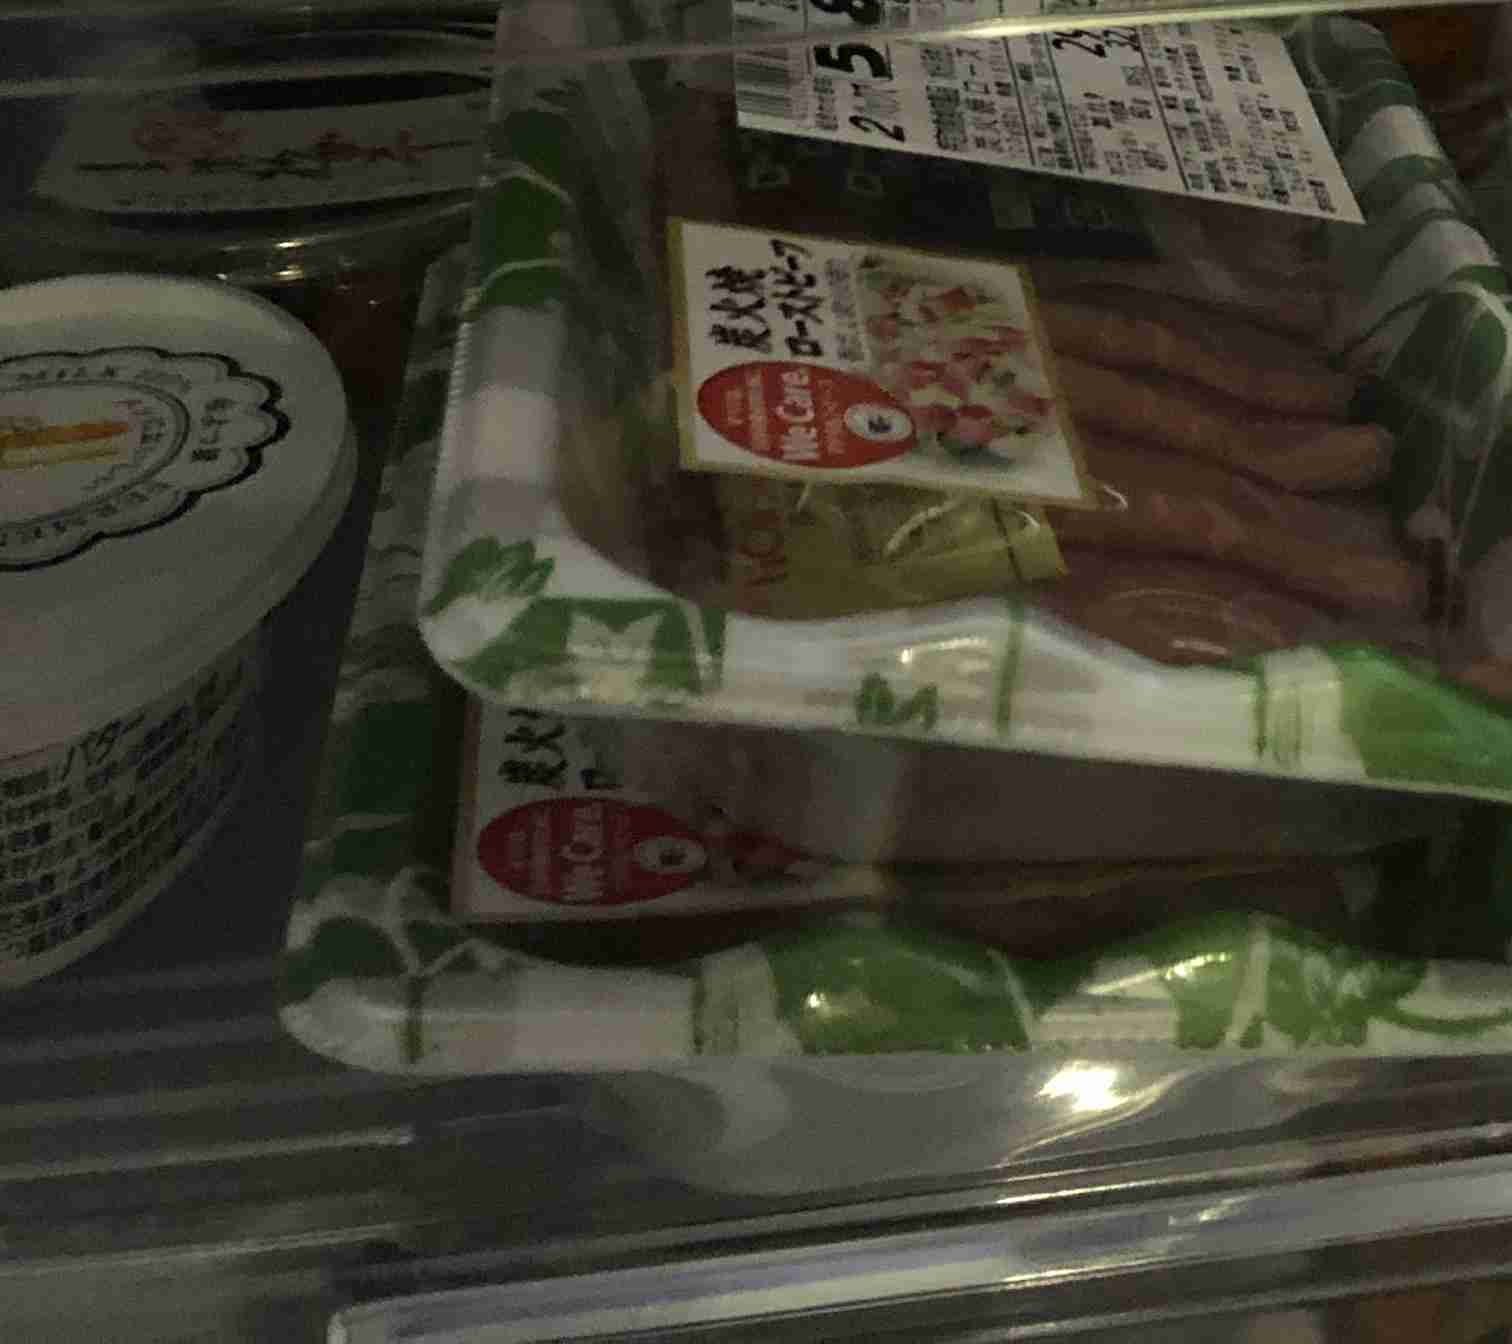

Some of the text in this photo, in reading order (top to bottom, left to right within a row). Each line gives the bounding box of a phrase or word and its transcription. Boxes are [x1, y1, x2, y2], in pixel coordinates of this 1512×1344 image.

[705, 265, 773, 353] 炭火焼
[769, 238, 823, 358] ローストビーフ
